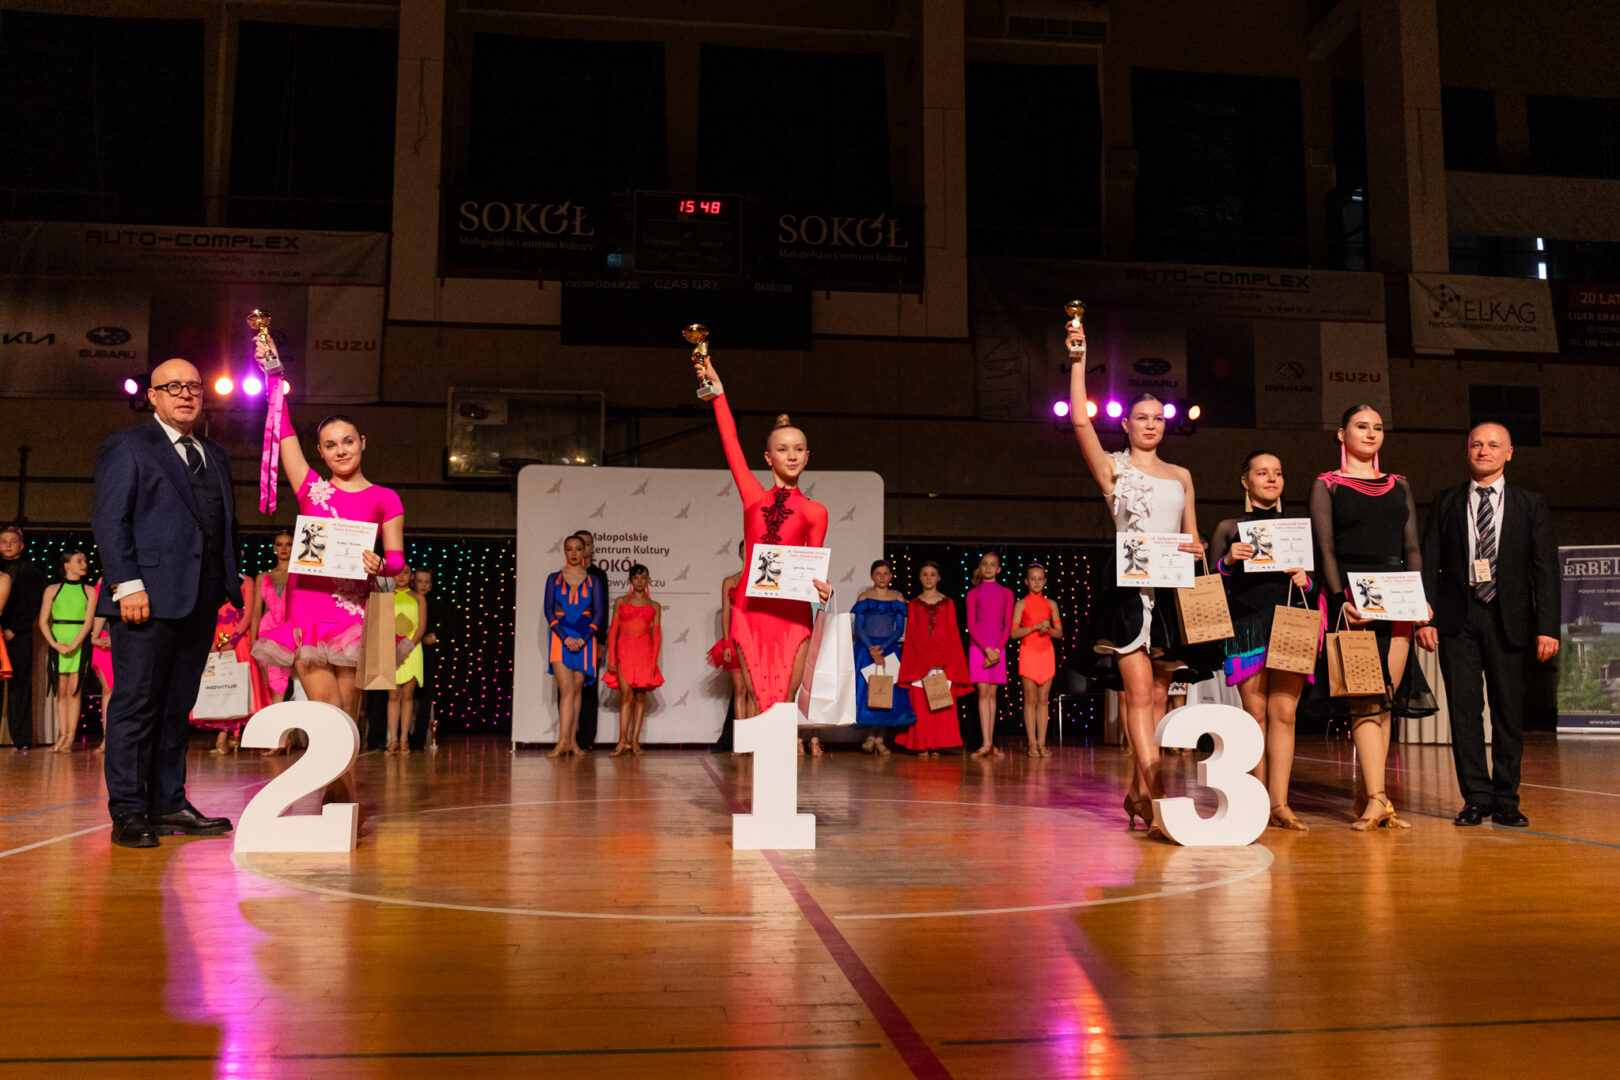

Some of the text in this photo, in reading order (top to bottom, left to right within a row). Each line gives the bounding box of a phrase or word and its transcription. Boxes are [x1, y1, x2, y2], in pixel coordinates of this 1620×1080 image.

[679, 200, 721, 215] 15 48
[86, 230, 299, 250] AUTO-COMPLEX
[566, 280, 641, 290] GOSPODARZE
[1126, 268, 1310, 288] AUTO-COMPLEX
[653, 279, 720, 292] CZAS GRY
[1580, 291, 1597, 305] 20
[3, 331, 56, 345] KIA
[315, 340, 376, 351] ISUZU
[78, 348, 137, 359] SUBARU
[1127, 379, 1177, 389] SUBARU
[1329, 371, 1381, 383] ISUZU
[633, 545, 670, 557] Kultury
[234, 700, 361, 853] 2
[732, 702, 816, 850] 1
[1152, 703, 1271, 847] 3
